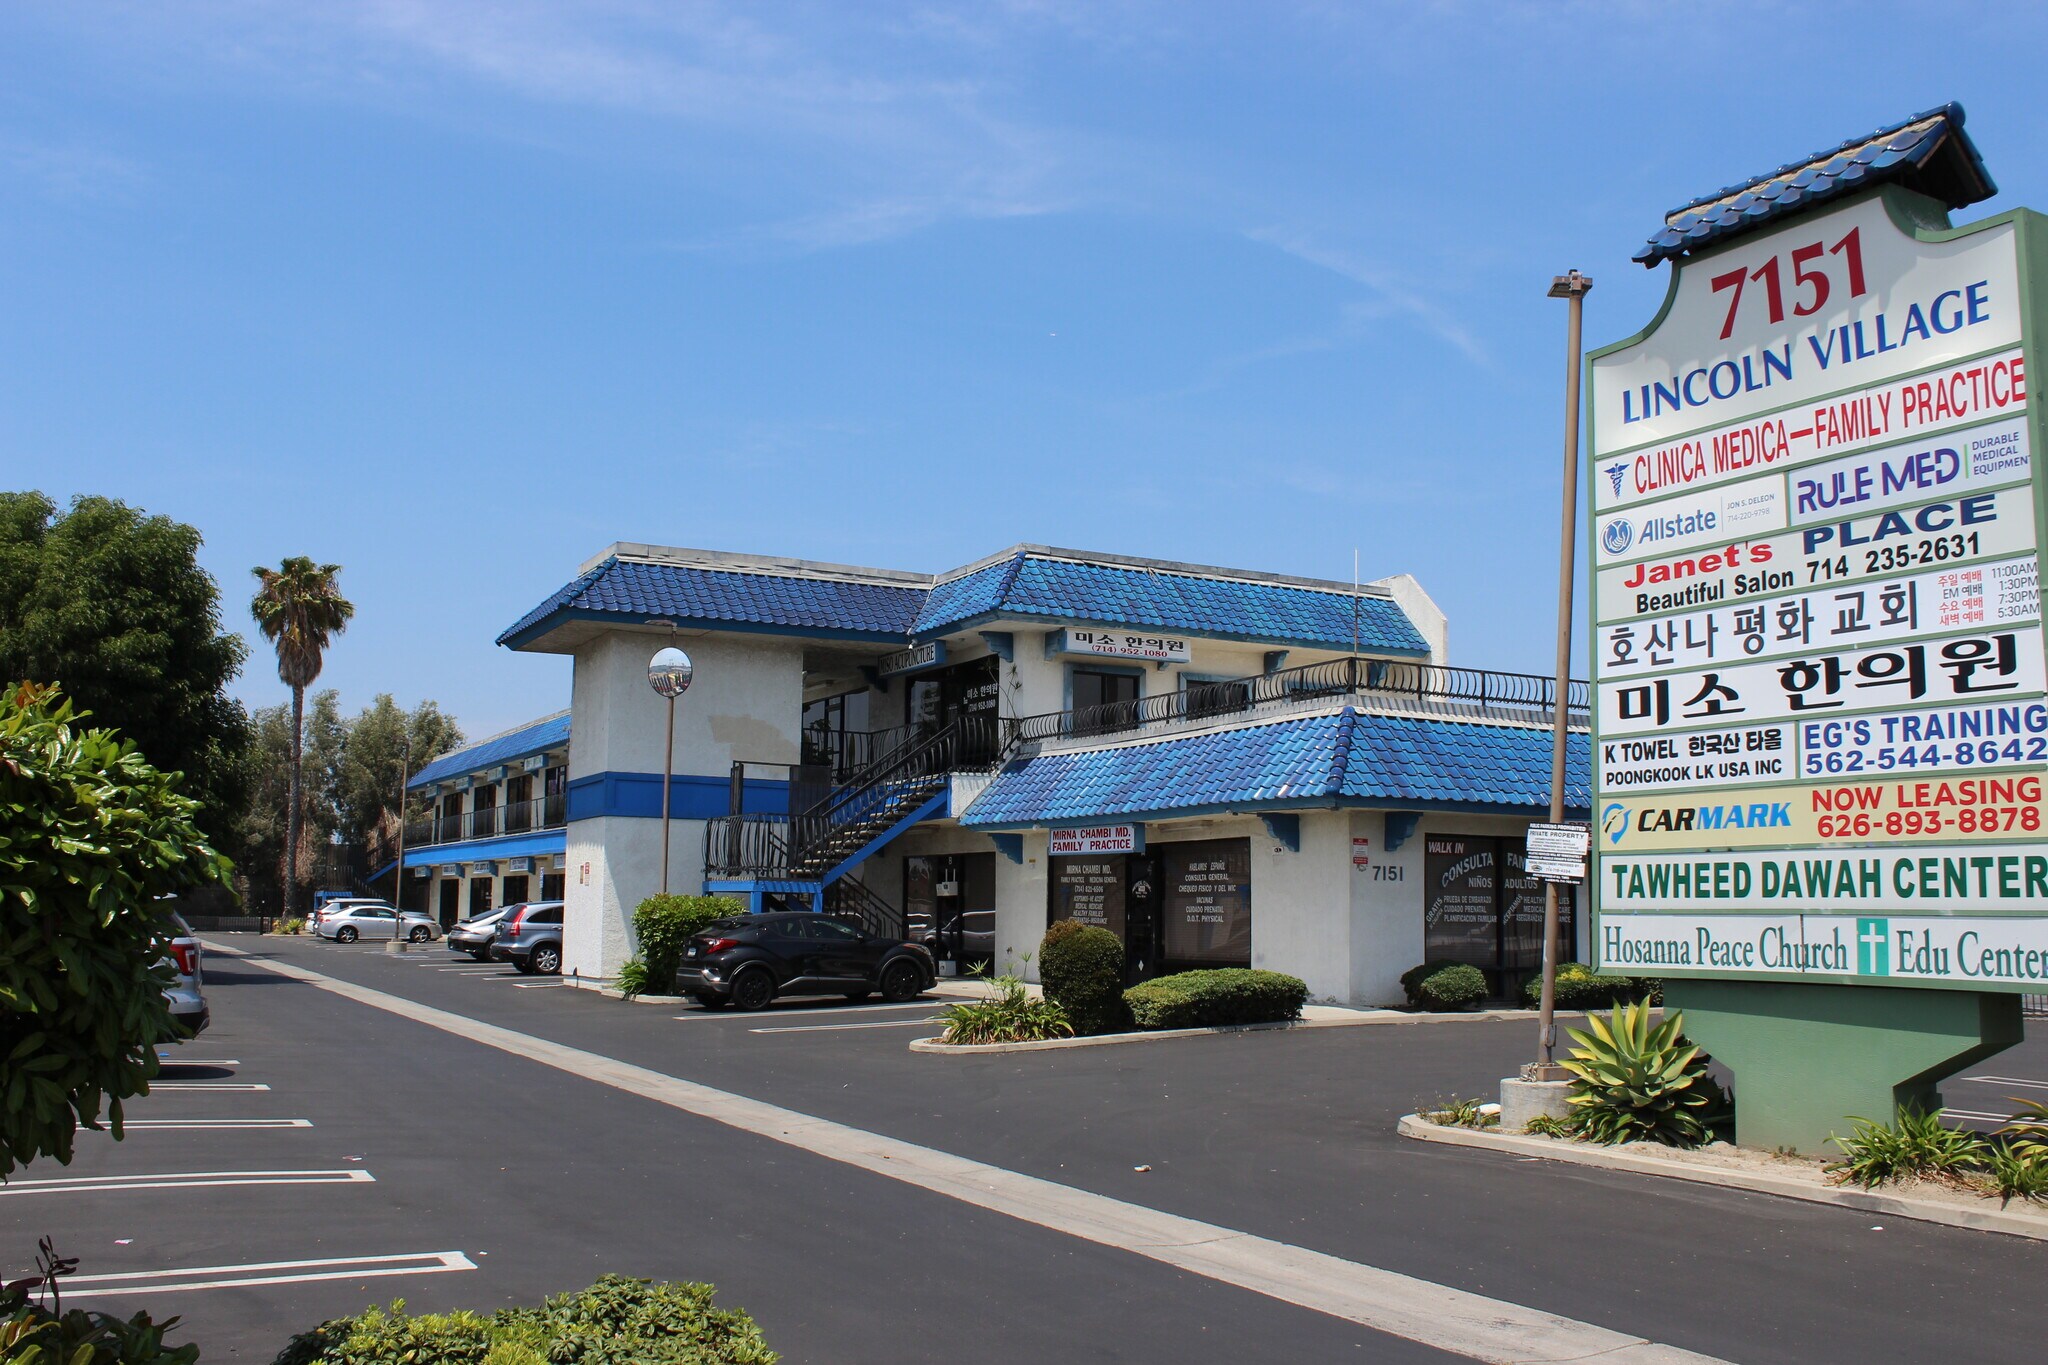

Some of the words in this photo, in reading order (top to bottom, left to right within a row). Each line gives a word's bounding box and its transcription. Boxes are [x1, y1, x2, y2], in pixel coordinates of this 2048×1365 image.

[1711, 226, 1866, 340] 7151
[1622, 343, 1793, 425] LINCOLN
[1808, 279, 1990, 371] VILLAGE
[1634, 441, 1707, 494] CLINICA
[1903, 357, 2027, 428] PRACTICE
[1972, 431, 2020, 451] DURABLE
[1973, 445, 2019, 463] MEDICAL
[1797, 466, 1873, 515] RULE
[1881, 447, 1960, 497] MED
[1727, 502, 1740, 510] JON
[1748, 493, 1775, 506] DELEON
[1727, 507, 1770, 523] 714-220-9798
[1638, 508, 1717, 546] Allstate
[1624, 541, 1773, 589] Janet's
[1803, 493, 1998, 555] PLACE
[1636, 578, 1725, 614] Beautiful
[1734, 569, 1794, 596] Salon
[1807, 555, 1849, 583] 714
[1865, 531, 1980, 574] 235-2631
[1961, 569, 1982, 584] 예배
[1992, 561, 2037, 579] 11:00AM
[1943, 588, 1959, 600] EM
[1961, 583, 1983, 597] 예배
[1999, 575, 2038, 591] 1:30PM
[1962, 596, 1983, 610] 예배
[1998, 589, 2039, 605] 7:30PM
[1962, 609, 1984, 623] 예배
[1998, 602, 2040, 619] 5:30AM
[1607, 614, 1719, 667] 호산나
[1733, 598, 1815, 655] 평화
[1831, 581, 1917, 635] 교회
[1075, 632, 1116, 646] 미소
[1125, 636, 1184, 652] 한의원
[1092, 645, 1117, 653] (714)
[1120, 648, 1168, 657] 952-1080
[1616, 673, 1746, 726] 미소
[1777, 634, 2019, 711] 한의원
[1805, 720, 1871, 750] EG'S
[1881, 705, 2047, 744] TRAINING
[1605, 744, 1616, 764] K
[1621, 739, 1679, 763] TOWEL
[1688, 732, 1741, 757] 한국산
[1745, 728, 1782, 751] 타올
[1806, 737, 2047, 775] 562-544-8642
[1606, 766, 1691, 786] POONGKOOK
[1696, 764, 1714, 779] LK
[1719, 761, 1750, 778] USA
[1755, 758, 1782, 775] INC
[1812, 786, 1883, 812] NOW
[1897, 777, 2042, 808] LEASING
[1637, 802, 1792, 832] CARMARK
[1817, 806, 2041, 838] 626-893-8878
[1053, 830, 1077, 840] MIRNA
[1080, 828, 1112, 839] CHAMBI
[1115, 827, 1131, 837] MD.
[1052, 841, 1083, 852] FAMILY
[1090, 839, 1131, 850] PRACTICE
[1428, 842, 1452, 853] WALK
[1454, 843, 1464, 854] IN
[1066, 865, 1082, 874] MIRNA
[1082, 865, 1101, 874] CHAMBI
[1208, 873, 1229, 881] GENERAL
[1372, 865, 1403, 882] 7151
[1441, 852, 1494, 888] CONSULTA
[1612, 861, 1751, 899] TAWHEED
[1762, 859, 1881, 898] DAWAH
[1893, 855, 2048, 898] CENTER
[1468, 876, 1493, 888] NIÑOS
[1504, 879, 1538, 889] ADULTOS
[1201, 915, 1224, 923] PHYSICAL
[1426, 897, 1442, 922] GRATIS
[1443, 905, 1464, 913] CUIDADO
[1464, 905, 1487, 913] PRENATAL
[1443, 914, 1476, 922] PLANIFICACION
[1477, 915, 1498, 923] FAMILIAR
[1604, 926, 1691, 965] Hosanna
[1696, 927, 1753, 967] Peace
[1759, 925, 1848, 970] Church
[1896, 928, 1950, 975] Edu
